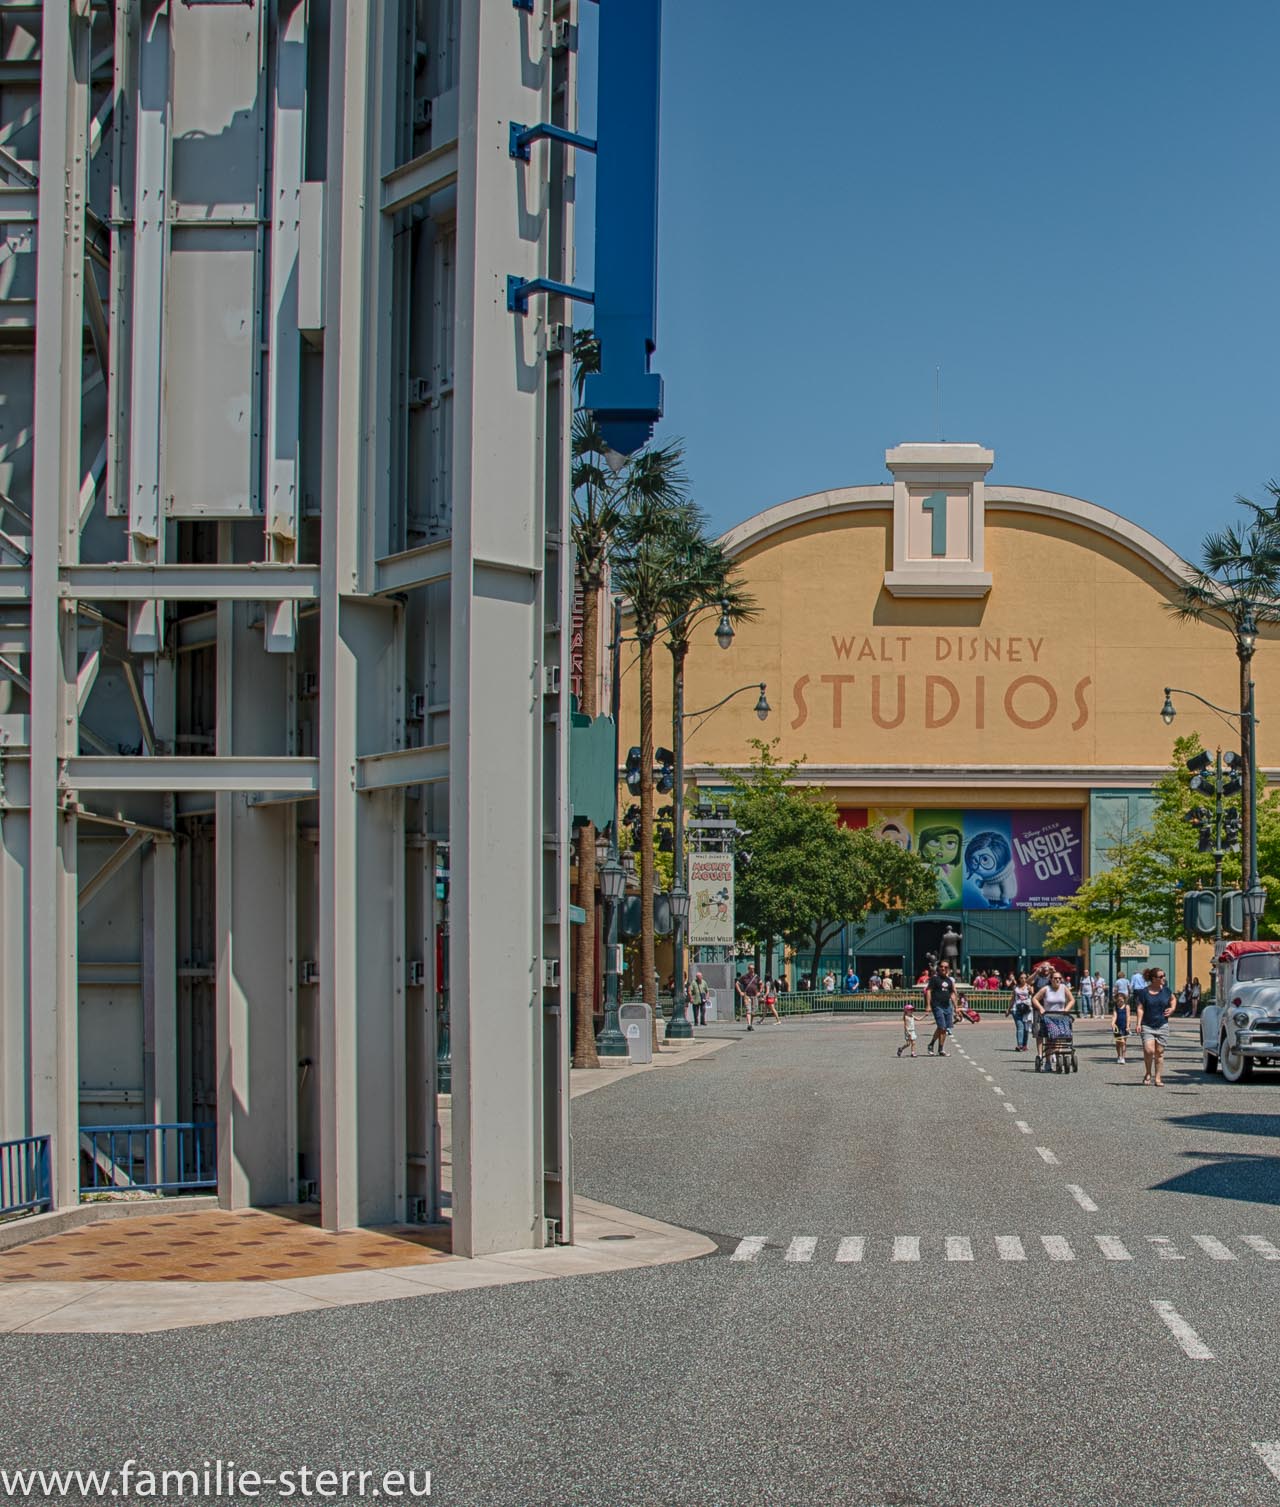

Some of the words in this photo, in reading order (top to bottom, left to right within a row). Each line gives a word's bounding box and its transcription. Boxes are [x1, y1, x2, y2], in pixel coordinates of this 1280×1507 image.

[921, 491, 947, 557] 1
[831, 635, 912, 662] WALT
[935, 636, 1044, 662] DISNEY
[790, 674, 1092, 732] STUDIOS
[1013, 826, 1080, 866] INSIDE
[691, 871, 732, 881] MOUSE
[693, 862, 731, 871] MICKEY
[1034, 848, 1075, 881] OUT
